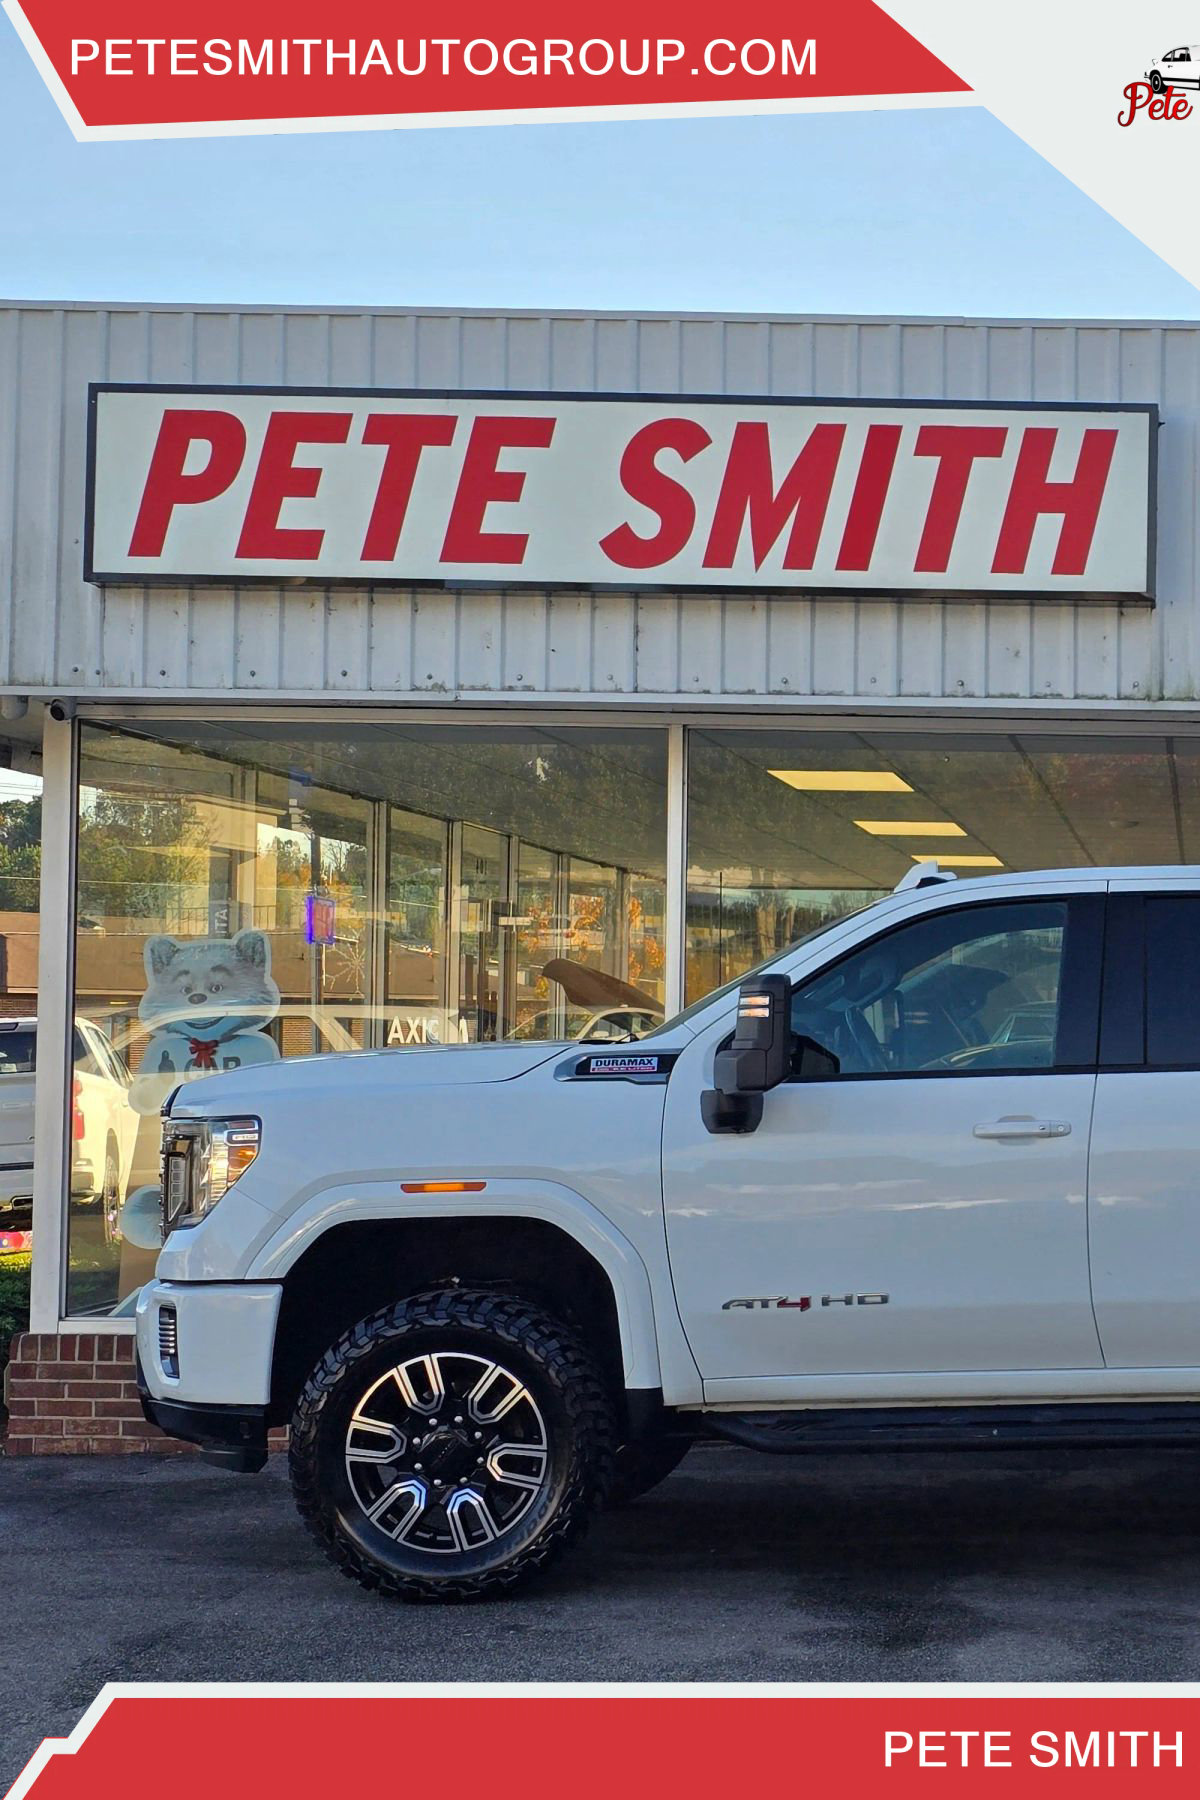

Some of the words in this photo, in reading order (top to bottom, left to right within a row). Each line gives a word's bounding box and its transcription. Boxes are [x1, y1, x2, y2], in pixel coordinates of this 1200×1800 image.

[130, 410, 556, 564] PETE
[600, 418, 1116, 574] SMITH
[595, 1058, 654, 1067] DURAMAX
[722, 1296, 811, 1312] AT4
[821, 1293, 889, 1306] HD
